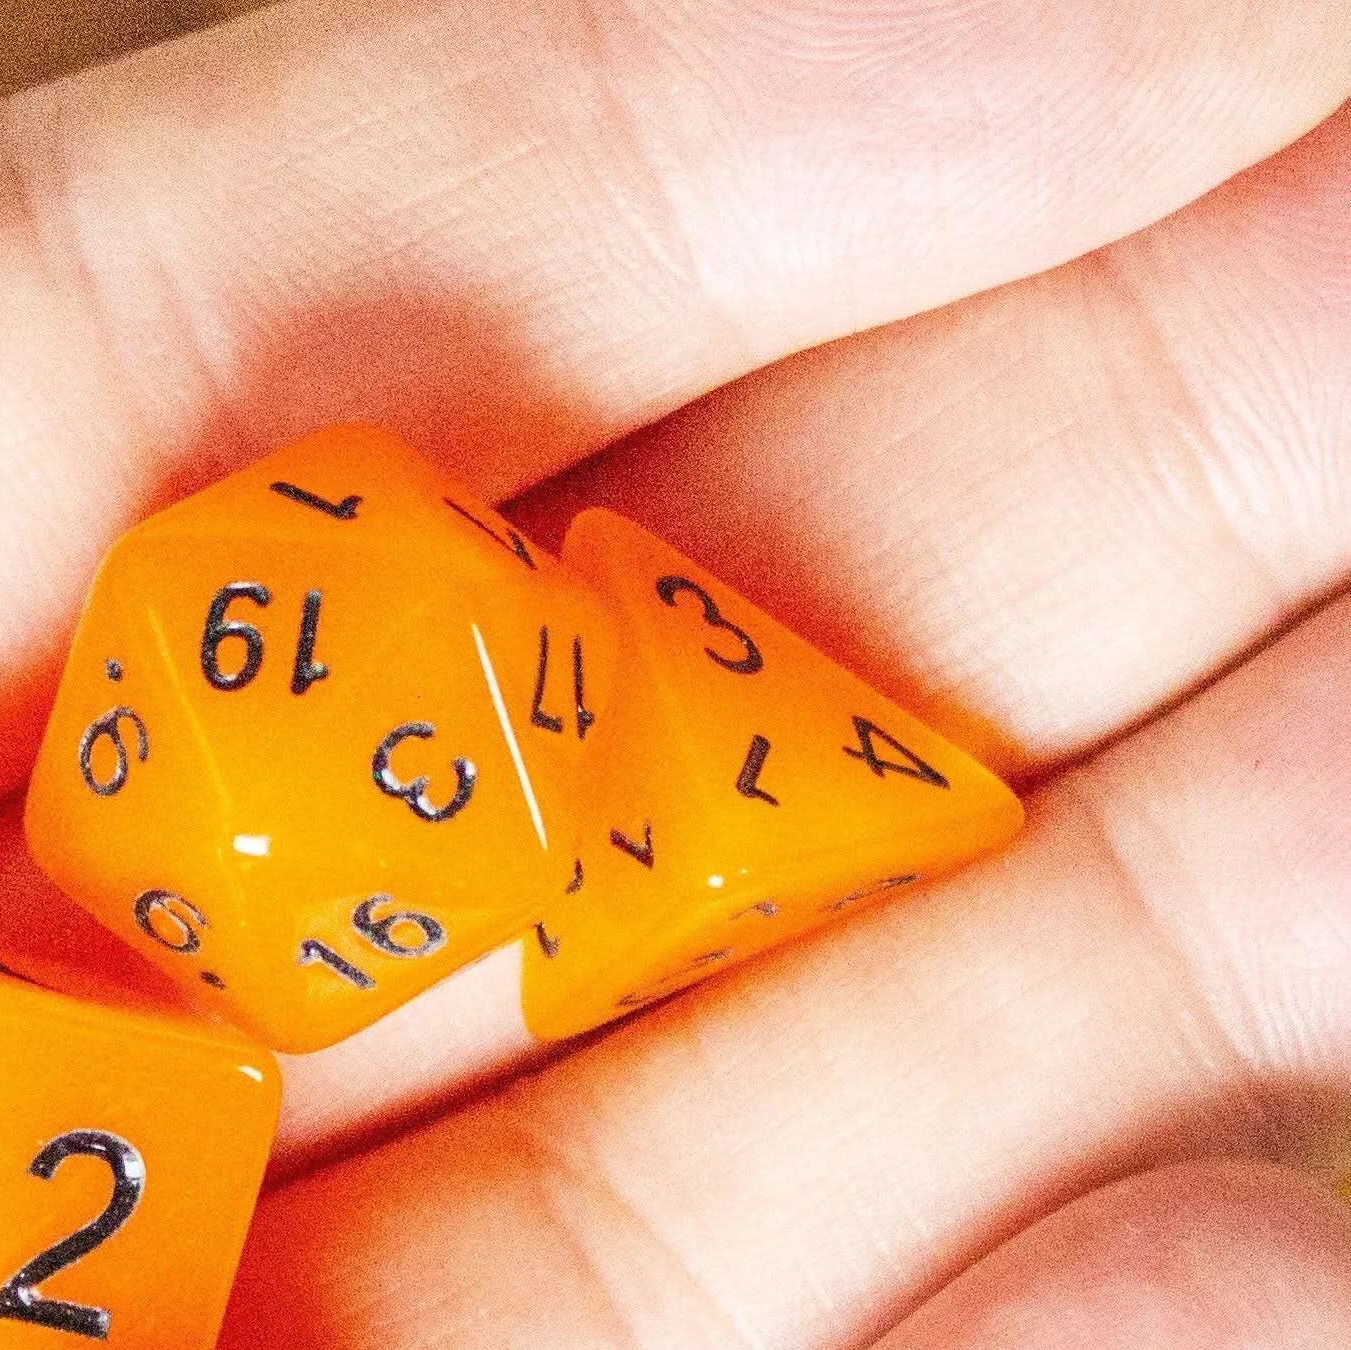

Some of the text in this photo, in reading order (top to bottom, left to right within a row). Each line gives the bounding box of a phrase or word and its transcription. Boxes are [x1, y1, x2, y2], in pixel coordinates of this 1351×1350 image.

[199, 584, 331, 697] 19
[656, 574, 764, 675] 3
[529, 625, 596, 741] 17
[371, 722, 477, 824] 3
[842, 714, 951, 790] 4
[300, 895, 444, 989] 16
